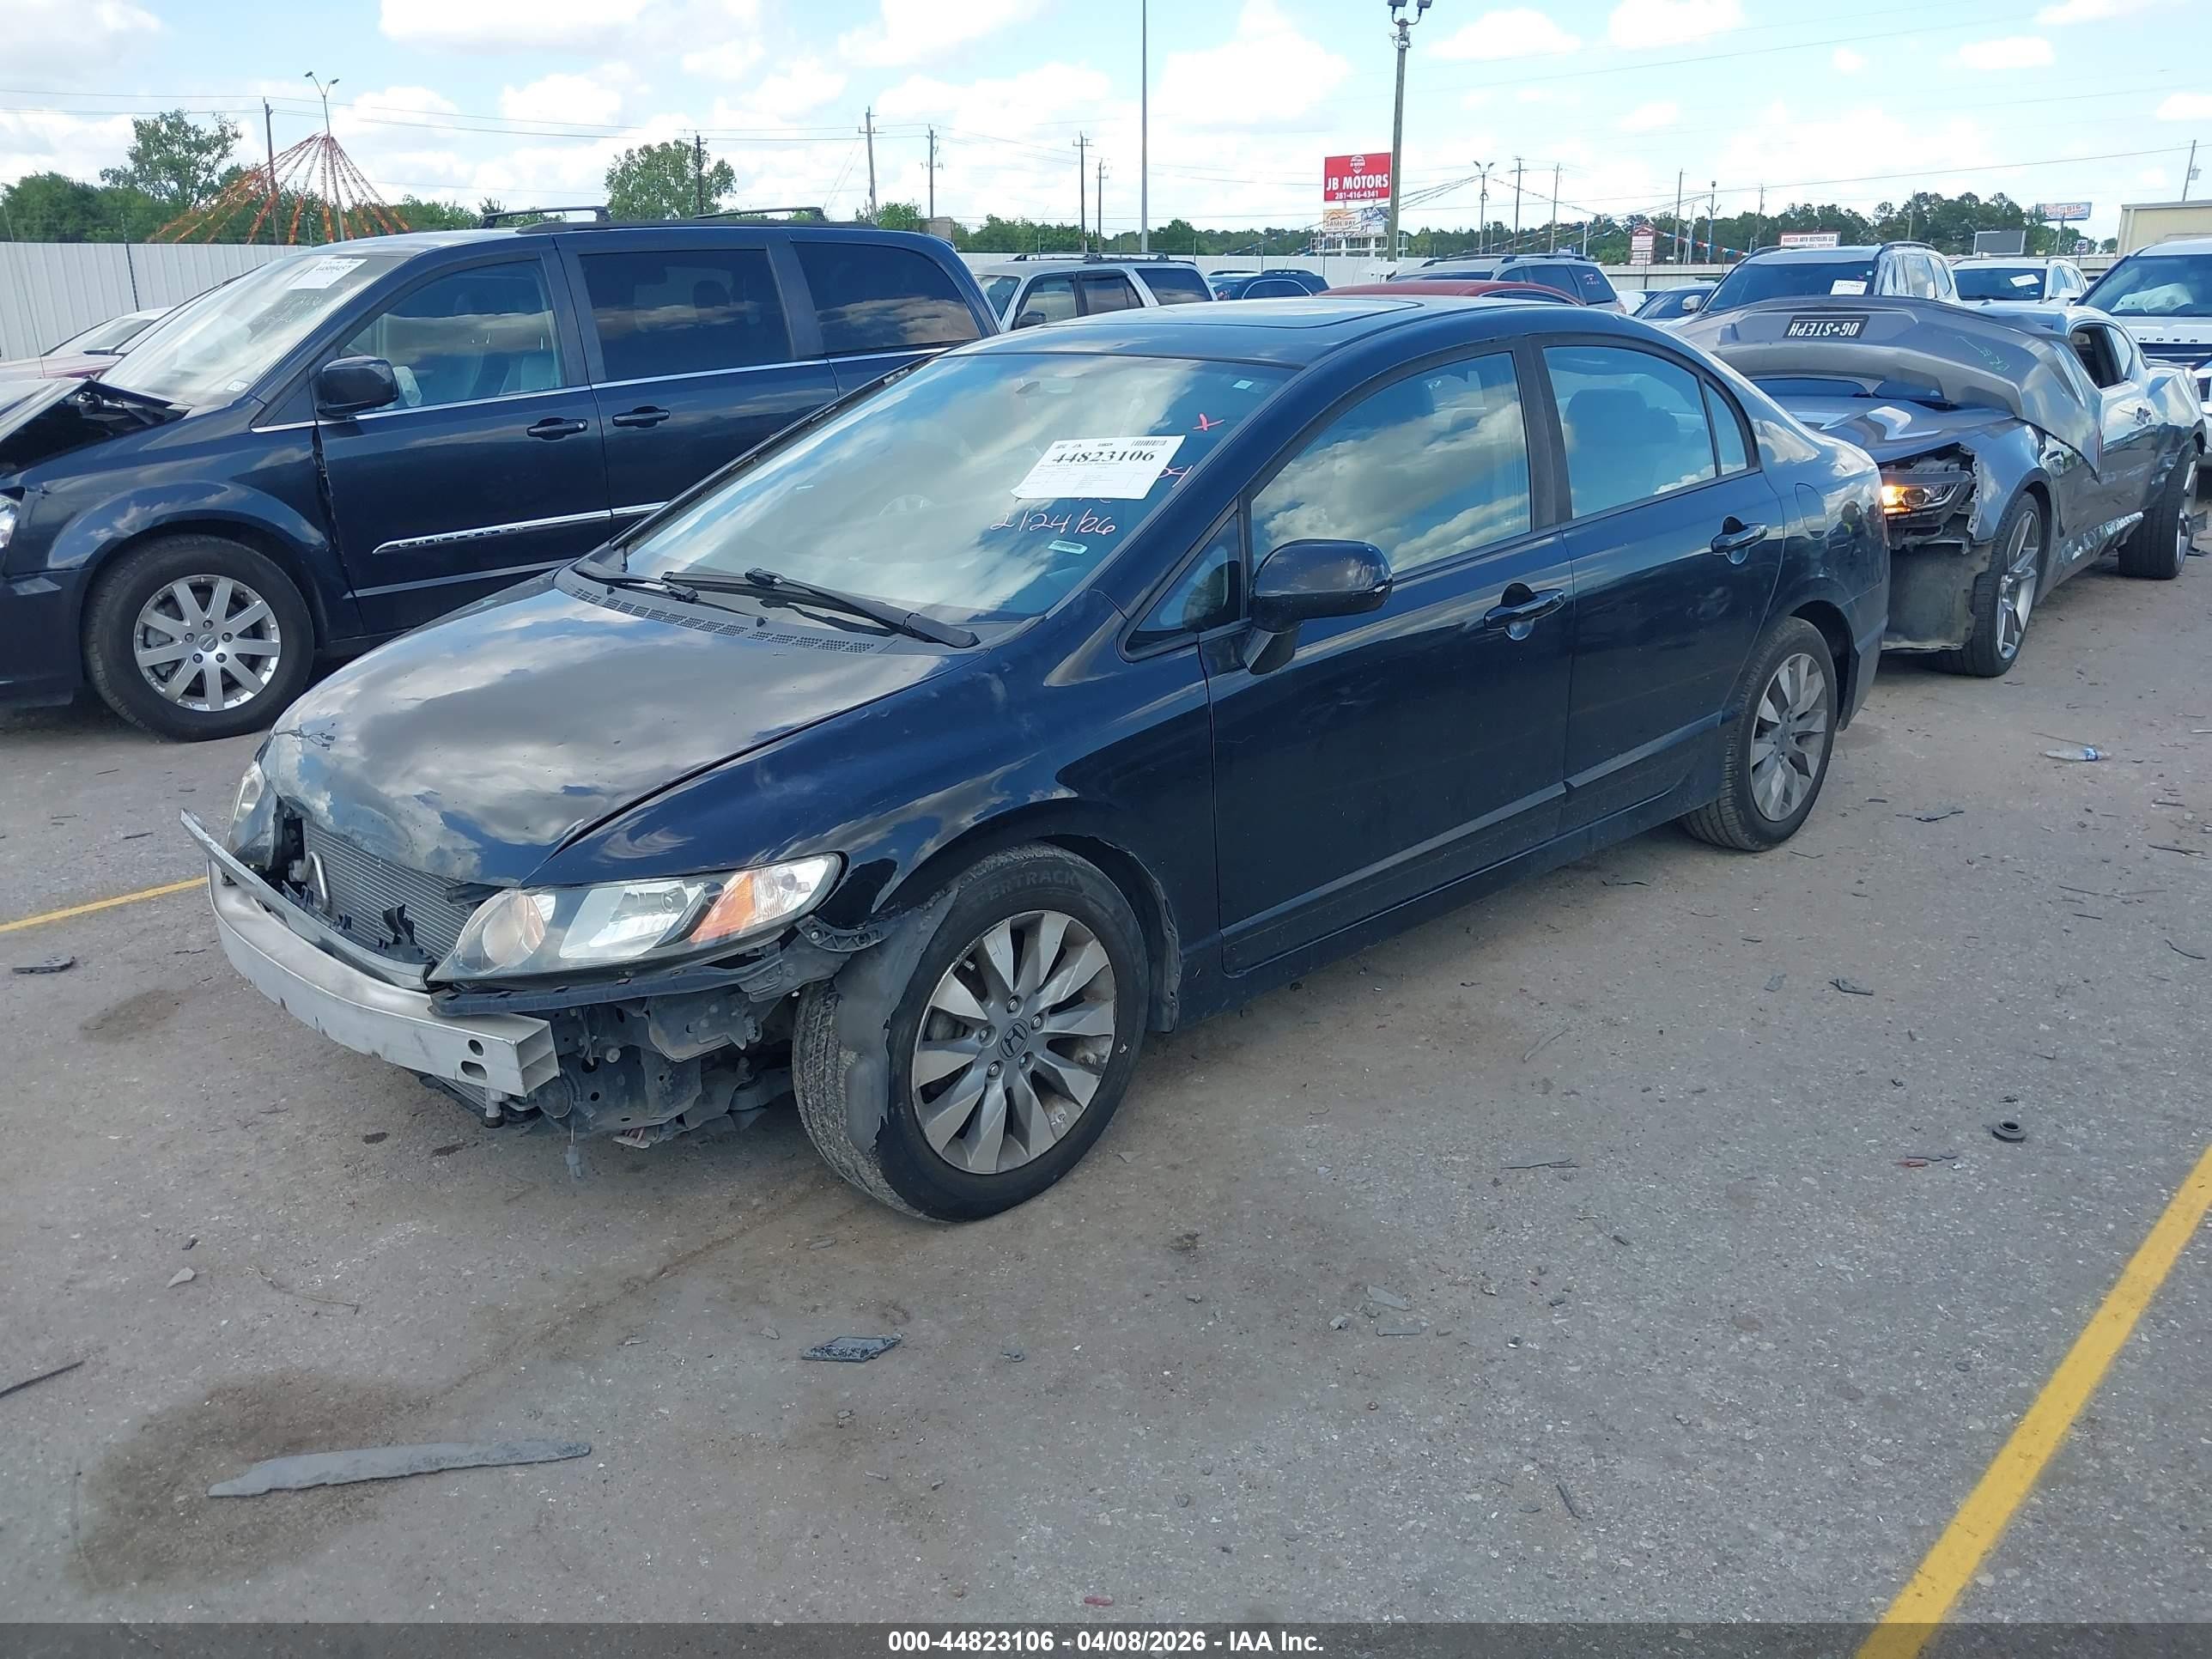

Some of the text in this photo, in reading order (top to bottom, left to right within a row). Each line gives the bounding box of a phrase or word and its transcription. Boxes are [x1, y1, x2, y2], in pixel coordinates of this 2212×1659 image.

[1327, 174, 1389, 191] JB MOTORS
[1335, 191, 1378, 200] 281-416-4341
[1053, 449, 1157, 464] 44823106
[398, 526, 525, 548] CHRYSLER
